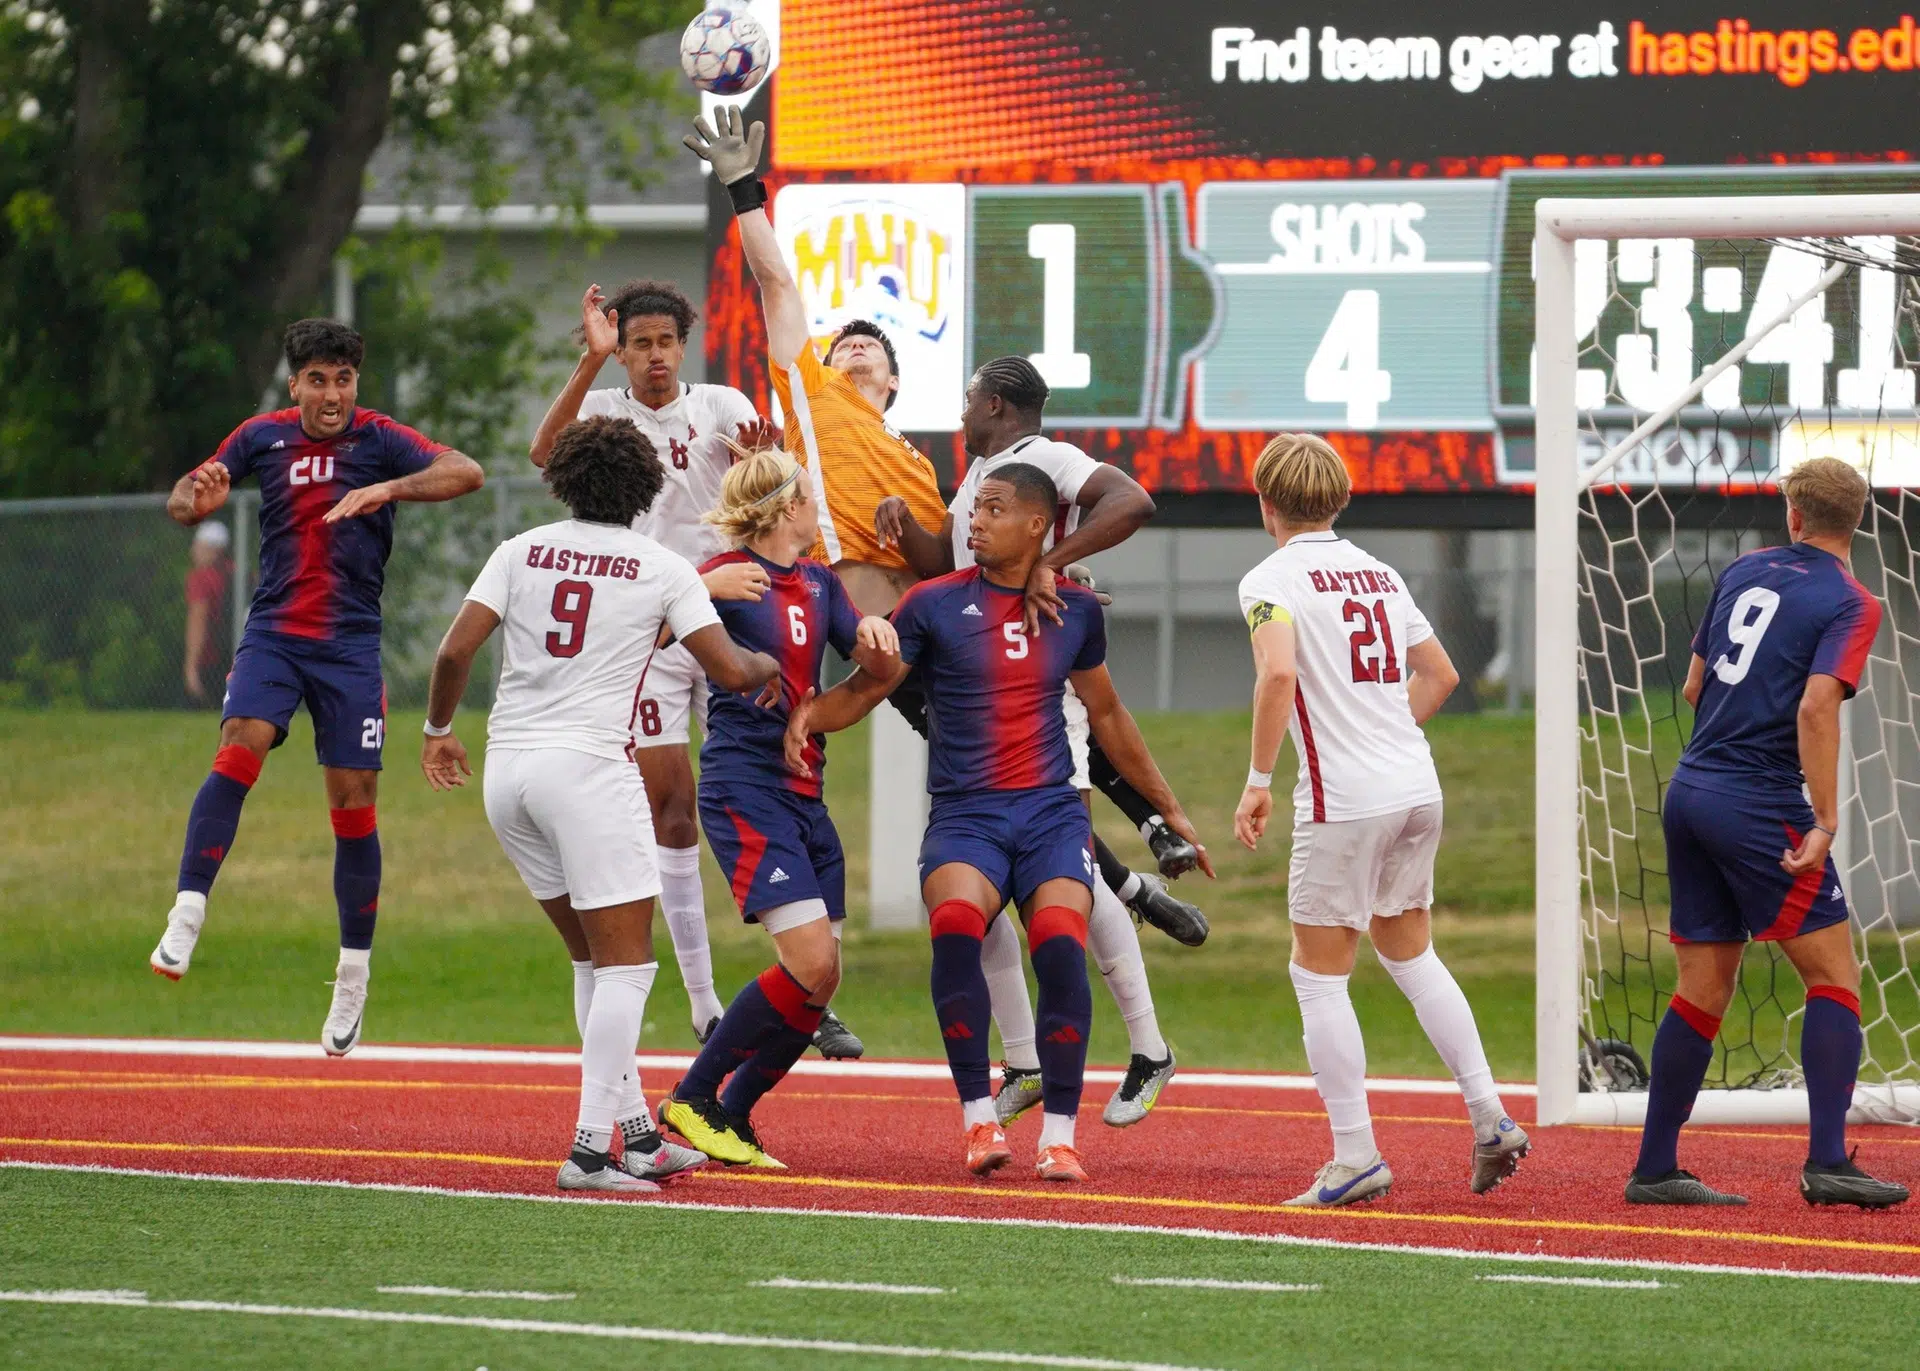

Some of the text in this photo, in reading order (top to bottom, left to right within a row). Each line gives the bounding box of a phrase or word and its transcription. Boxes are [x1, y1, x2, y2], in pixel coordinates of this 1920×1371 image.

[1211, 14, 1920, 93] Find team gear at hastings.ed
[794, 212, 948, 320] MNU
[1269, 202, 1427, 265] SHOTS
[1028, 224, 1091, 389] 1
[1304, 289, 1392, 428] 4
[289, 456, 334, 486] 20
[526, 544, 641, 580] HASTINGS
[545, 579, 594, 659] 9
[787, 605, 808, 646] 6
[1003, 621, 1029, 660] 5
[1342, 598, 1401, 684] 21
[1713, 586, 1780, 686] 9
[362, 717, 383, 749] 20
[638, 698, 662, 737] 8
